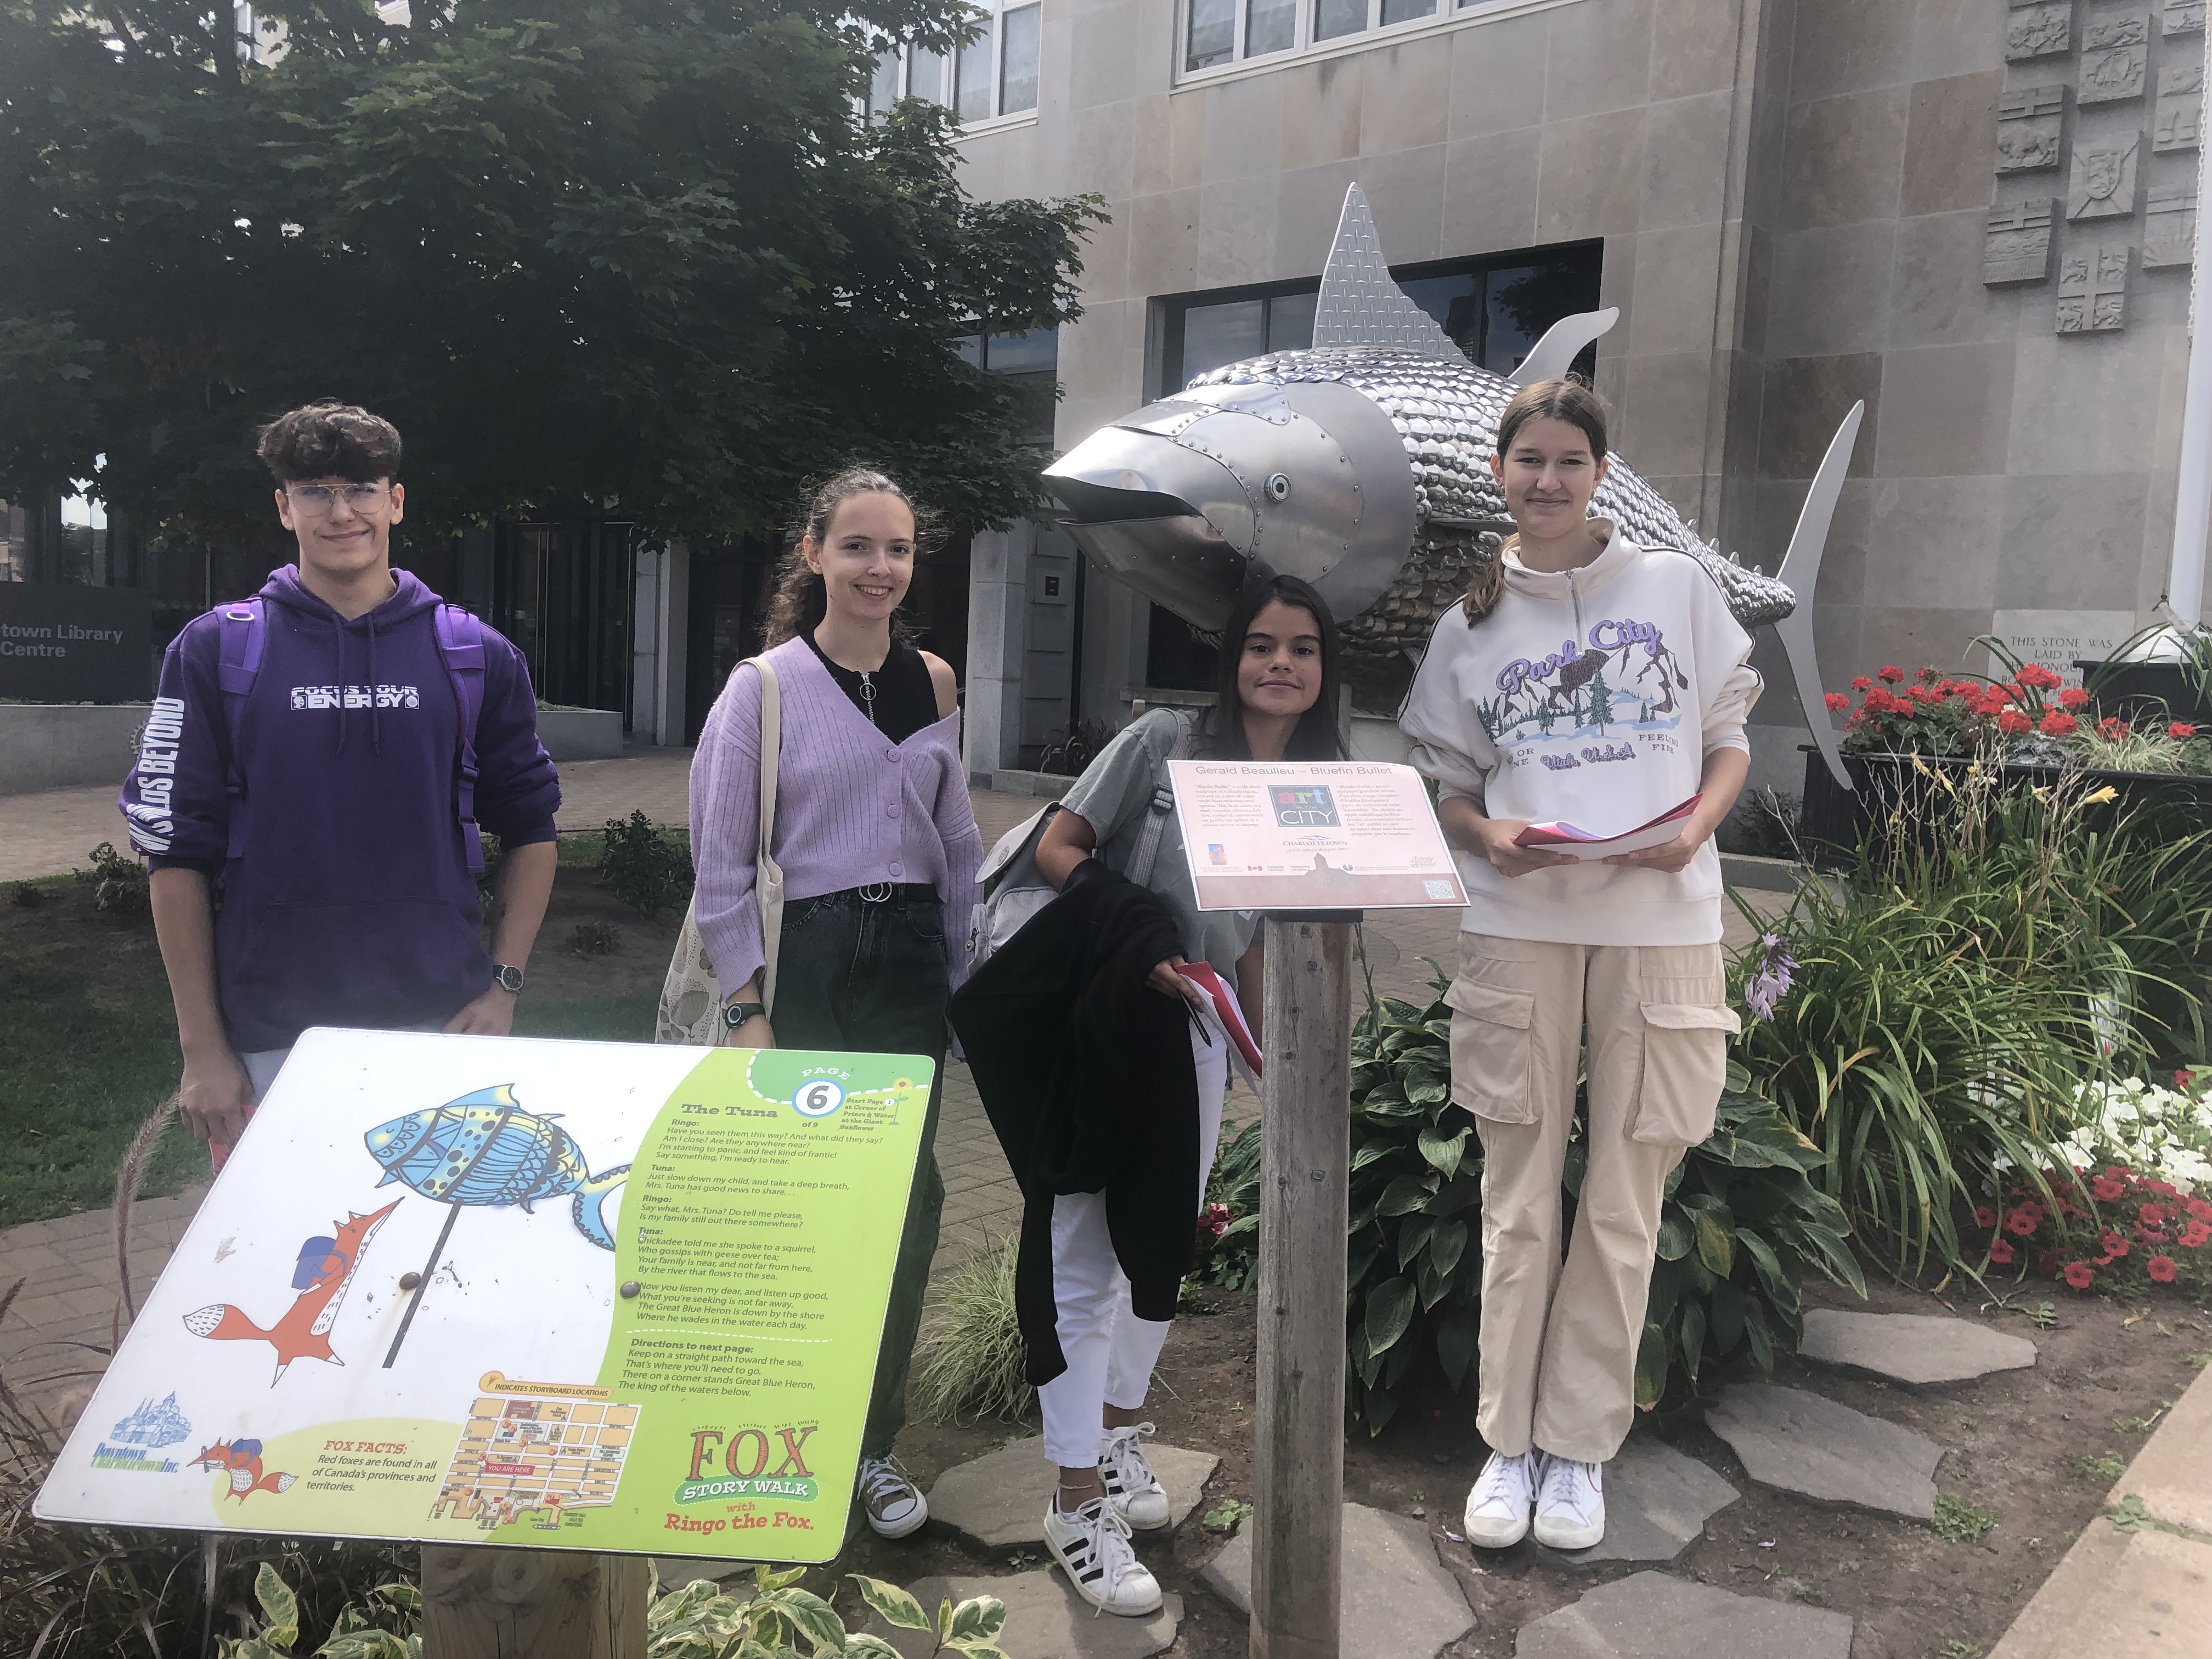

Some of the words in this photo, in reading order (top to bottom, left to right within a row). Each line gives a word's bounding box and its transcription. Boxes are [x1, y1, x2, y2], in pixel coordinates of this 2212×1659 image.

[57, 624, 123, 644] Library
[1, 641, 66, 657] Centre
[2010, 636, 2036, 647] THIS
[2041, 637, 2081, 648] STONE
[2089, 639, 2113, 648] WAS
[1496, 639, 1585, 695] Park
[1589, 618, 1663, 657] City
[2034, 650, 2062, 659] LAID
[2068, 651, 2083, 661] BY
[291, 686, 359, 696] FOCUS
[308, 693, 404, 709] ENERGY
[138, 697, 185, 774] BEYOND
[1195, 766, 1237, 775] Gerald
[1242, 766, 1295, 775] Beaulieu
[1311, 766, 1353, 775] Bluefin
[1357, 766, 1393, 775] Bullet
[1279, 788, 1327, 804] art
[1280, 810, 1333, 824] CITY
[801, 1066, 851, 1080] PAGE
[806, 1085, 830, 1109] 6
[681, 1104, 720, 1115] The
[725, 1106, 778, 1118] Tuna
[671, 1119, 700, 1127] Ringo:
[673, 1145, 704, 1153] starting
[726, 1138, 744, 1147] they
[672, 1154, 717, 1162] something,
[631, 1339, 684, 1348] Directions
[724, 1346, 753, 1354] page:
[628, 1348, 651, 1359] Keep
[675, 1353, 710, 1362] straight
[711, 1355, 732, 1363] path
[735, 1356, 768, 1364] toward
[770, 1357, 785, 1365] the
[627, 1359, 651, 1368] That's
[654, 1361, 681, 1370] where
[683, 1364, 709, 1372] you'll
[623, 1370, 647, 1379] There
[703, 1376, 733, 1384] stands
[736, 1377, 760, 1385] Great
[763, 1379, 783, 1387] Blue
[785, 1380, 815, 1390] Heron,
[529, 1386, 572, 1395] STORYBOARD
[572, 1388, 608, 1396] LOCATIONS
[619, 1381, 635, 1389] The
[637, 1382, 657, 1392] king
[671, 1384, 686, 1392] the
[721, 1387, 751, 1396] below.
[324, 1440, 354, 1451] FOX
[354, 1442, 408, 1454] FACTS:
[685, 1426, 817, 1481] FOX
[318, 1455, 337, 1464] Red
[338, 1455, 364, 1465] foxes
[382, 1458, 413, 1468] found
[413, 1460, 423, 1469] in
[424, 1460, 437, 1469] all
[312, 1468, 325, 1476] of
[324, 1468, 366, 1479] Canada's
[366, 1471, 414, 1481] provinces
[416, 1474, 437, 1482] and
[306, 1481, 355, 1491] territories.
[683, 1481, 750, 1502] STORY
[754, 1480, 809, 1497] WALK
[726, 1502, 755, 1513] with
[664, 1513, 726, 1536] Ringo
[731, 1513, 768, 1530] the
[772, 1512, 814, 1531] Fox.
